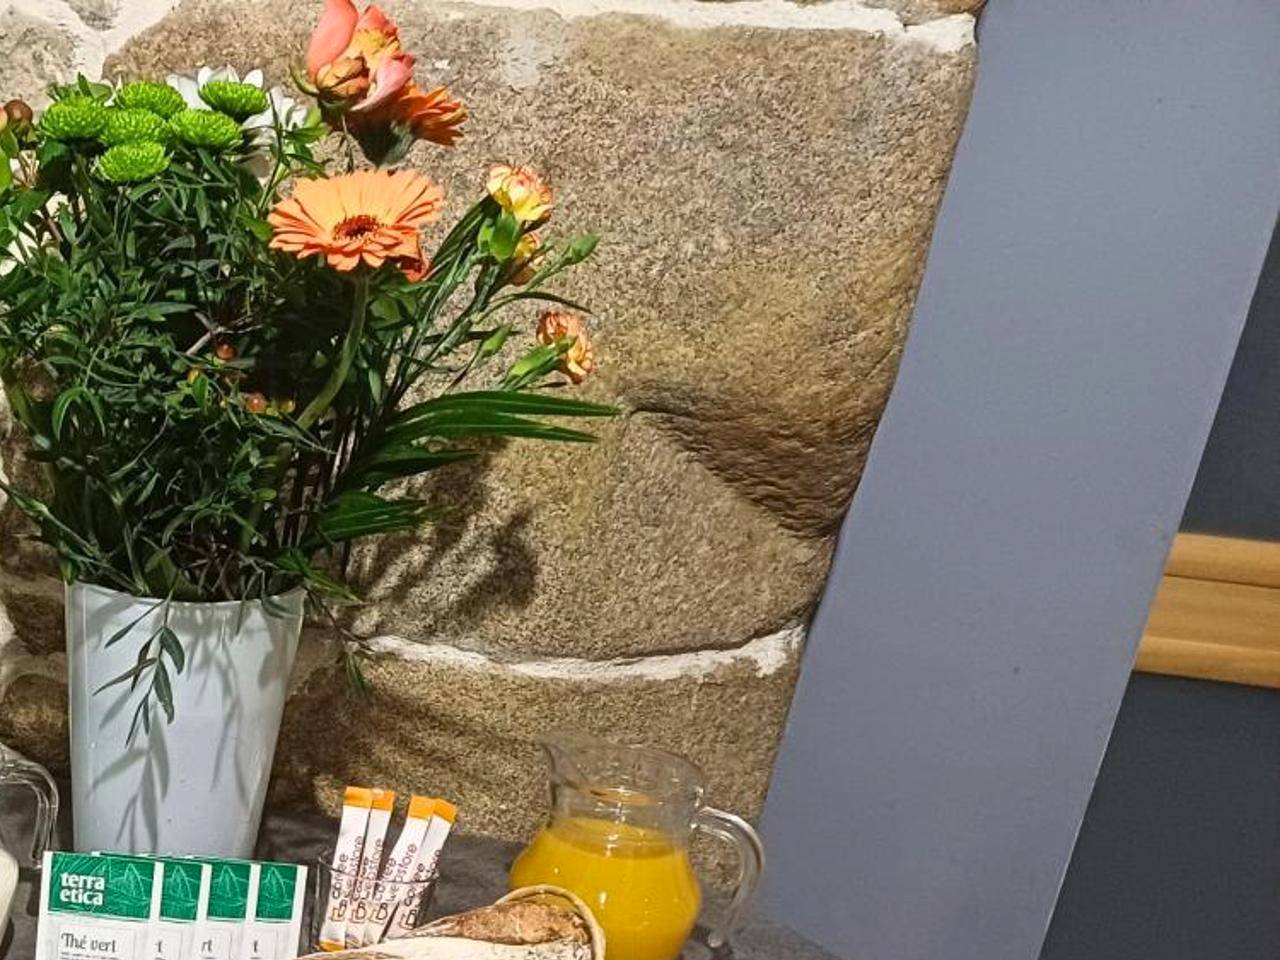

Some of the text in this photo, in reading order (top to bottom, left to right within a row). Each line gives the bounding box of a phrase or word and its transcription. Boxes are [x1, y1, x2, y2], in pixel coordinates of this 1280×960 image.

[61, 872, 105, 891] terra
[60, 888, 103, 906] etica
[61, 932, 116, 953] Thé vert
